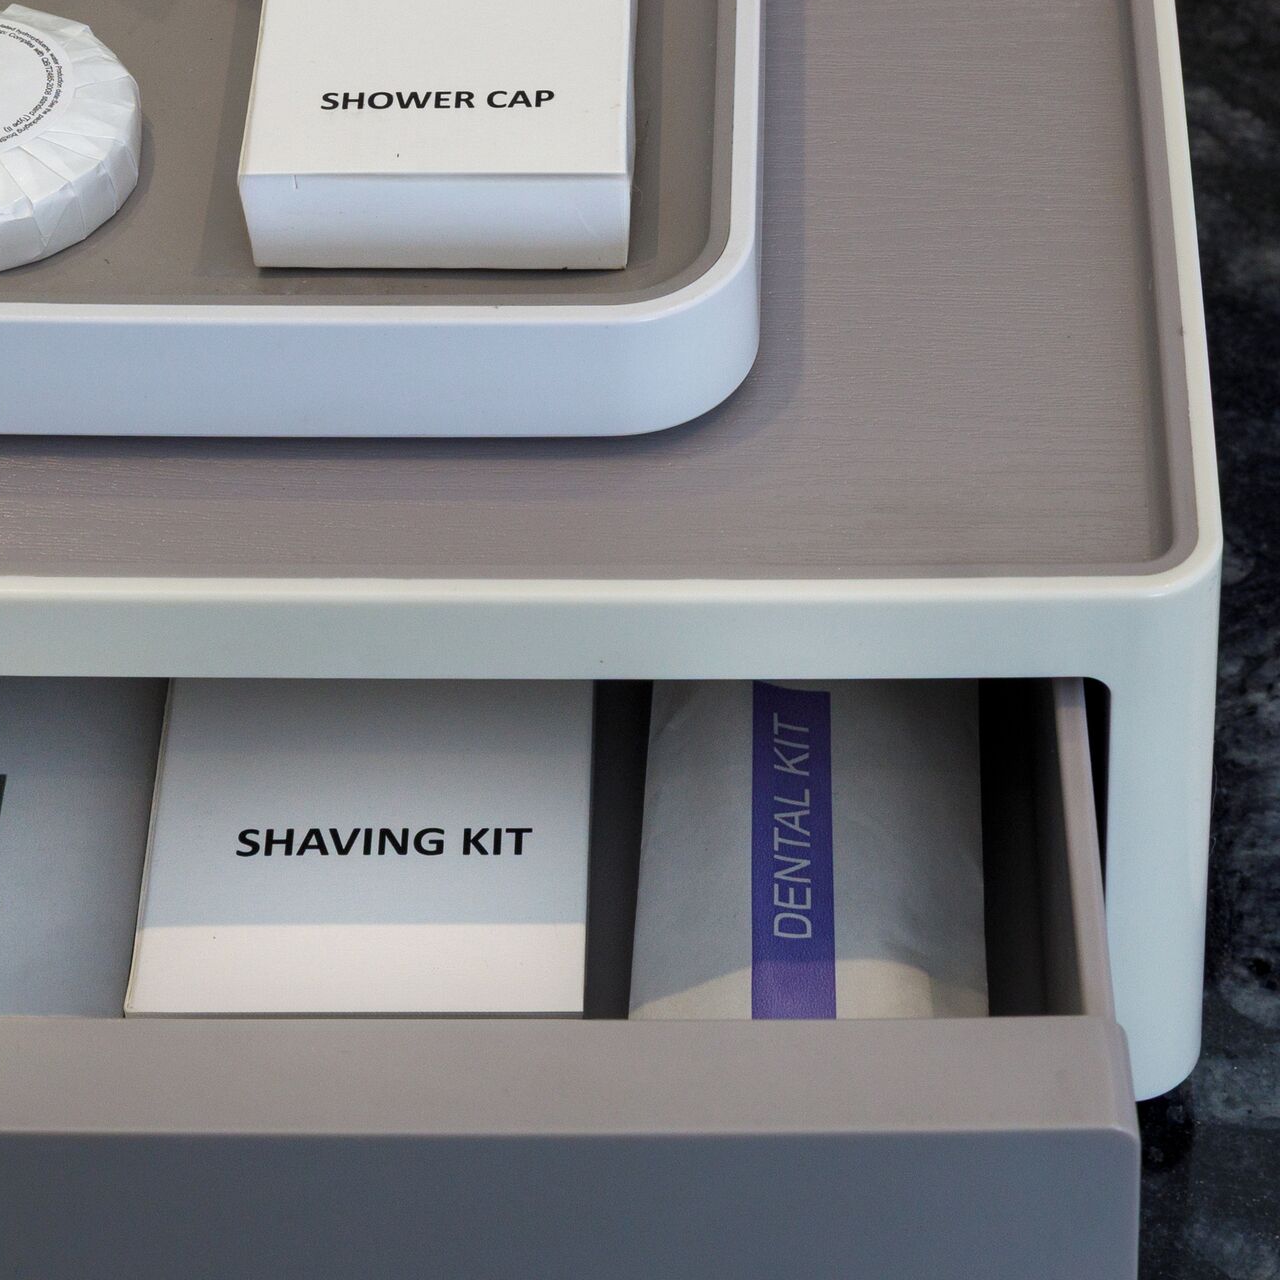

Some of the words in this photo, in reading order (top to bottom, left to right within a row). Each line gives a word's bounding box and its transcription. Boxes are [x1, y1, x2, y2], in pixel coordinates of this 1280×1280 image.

[320, 90, 476, 110] SHOWER
[486, 89, 555, 109] CAP
[773, 712, 810, 777] KIT
[236, 827, 446, 857] SHAVING
[462, 827, 533, 856] KIT
[773, 788, 812, 940] DENTAL
